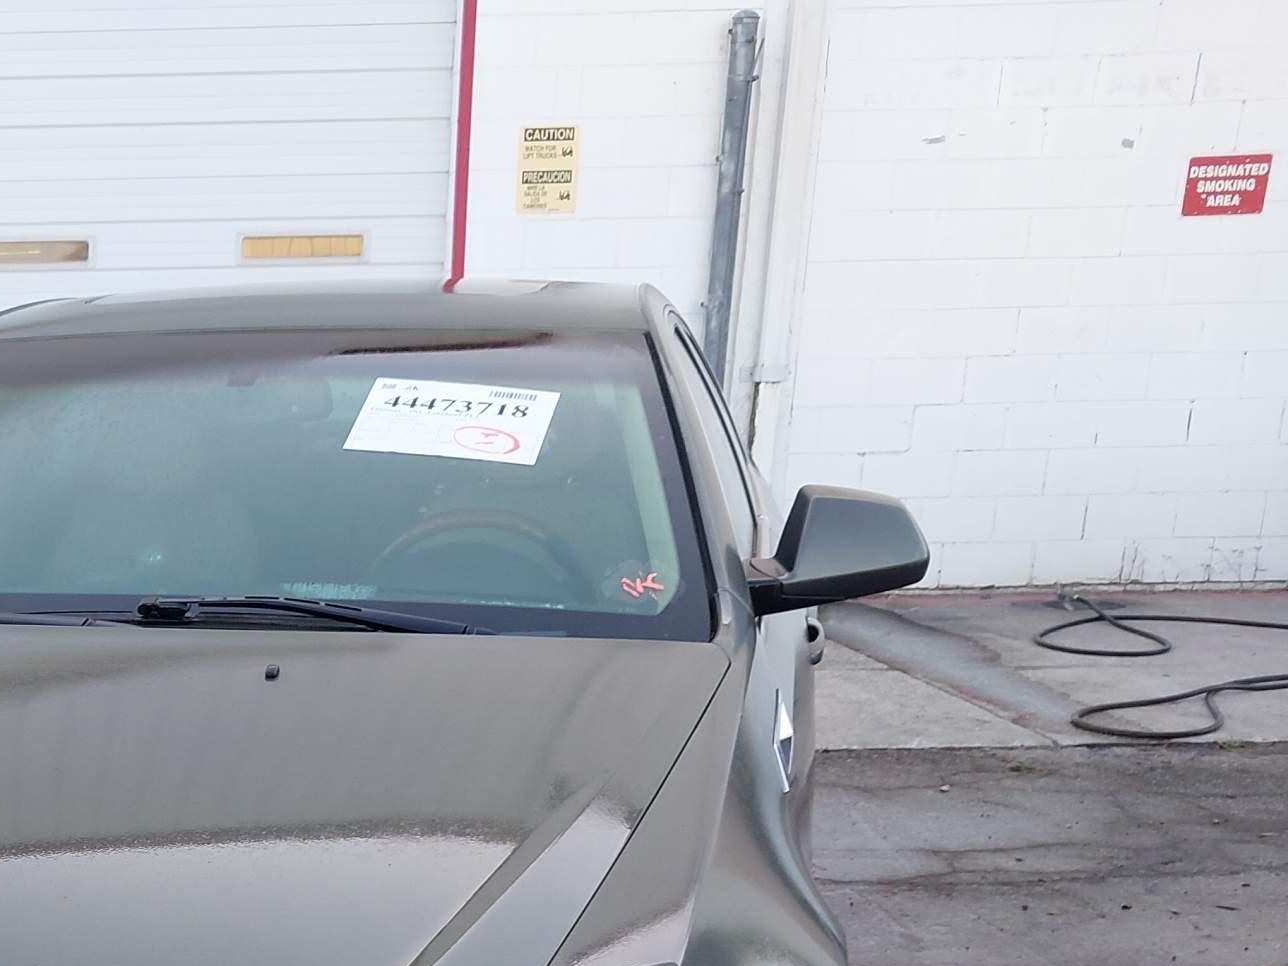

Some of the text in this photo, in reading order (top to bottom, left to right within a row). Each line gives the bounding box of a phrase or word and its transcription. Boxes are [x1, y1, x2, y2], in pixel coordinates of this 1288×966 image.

[525, 128, 574, 140] CAUTION
[1189, 163, 1269, 178] DESIGNATED
[1196, 178, 1256, 193] SMOKING
[1206, 194, 1240, 207] AREA
[383, 395, 529, 418] 44473718
